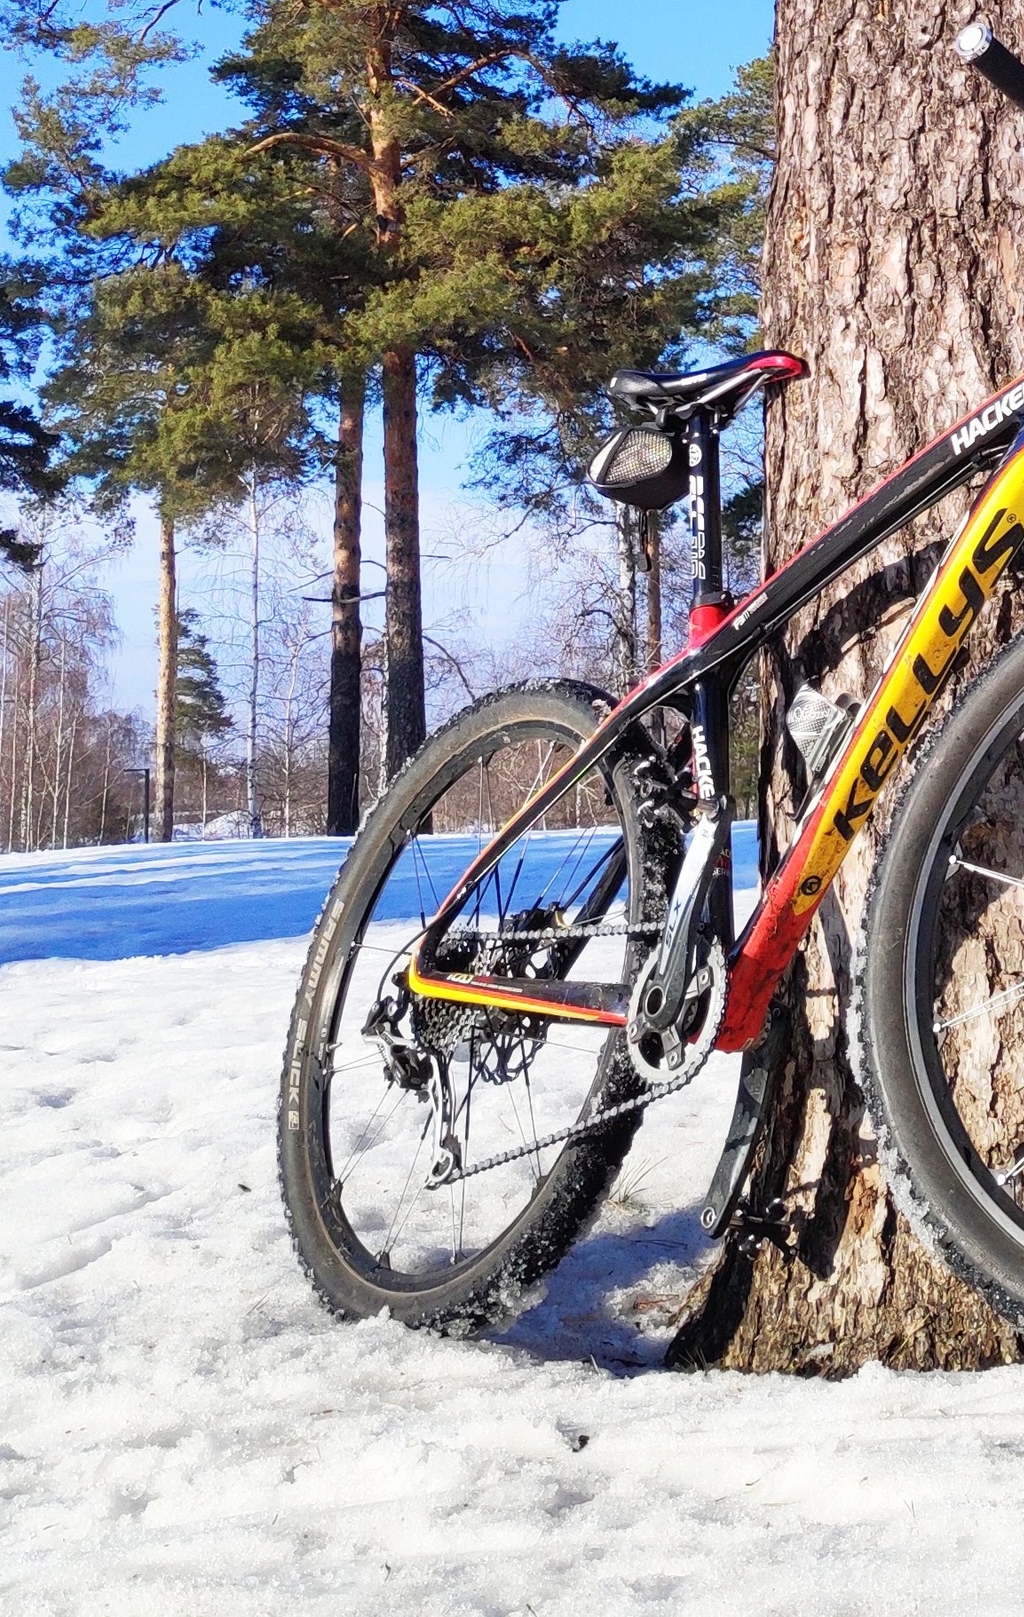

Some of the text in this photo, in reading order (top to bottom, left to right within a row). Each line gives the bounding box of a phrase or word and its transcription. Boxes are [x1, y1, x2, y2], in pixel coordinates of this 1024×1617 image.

[692, 725, 716, 800] HACKE
[304, 898, 345, 1008] SAMMY
[288, 1019, 308, 1108] SLICK
